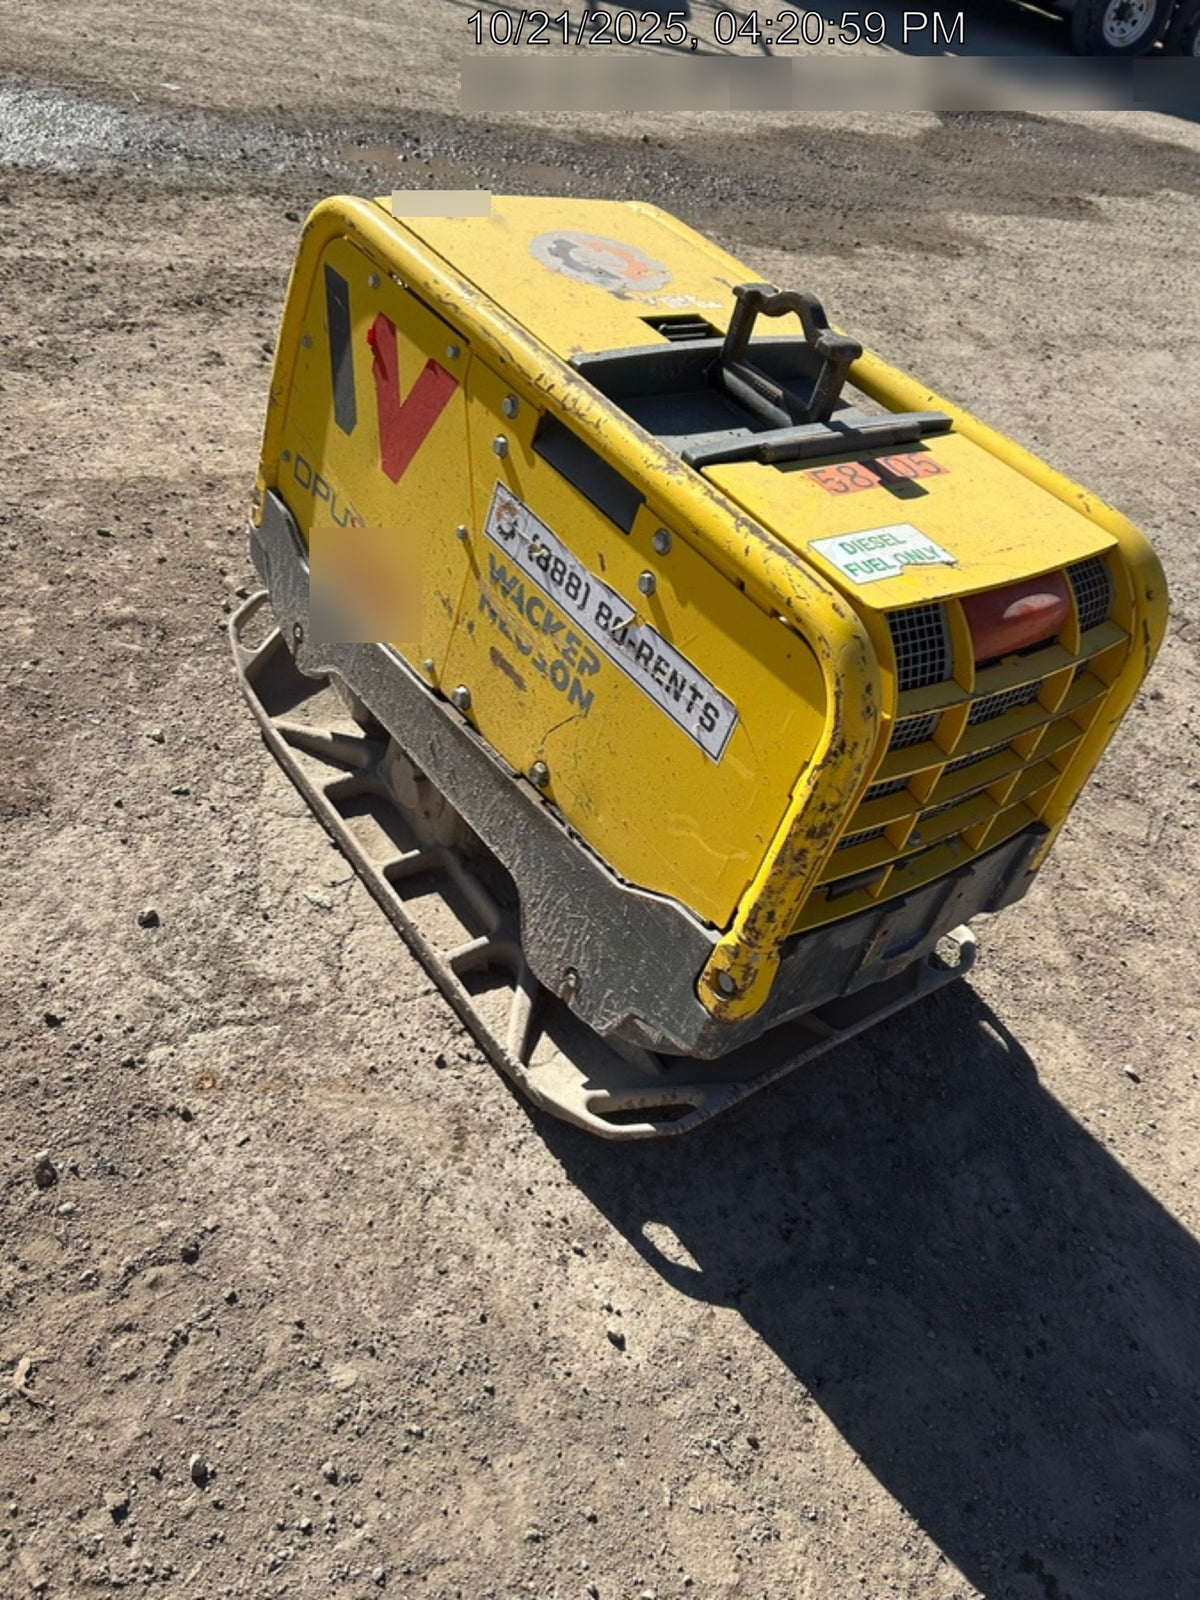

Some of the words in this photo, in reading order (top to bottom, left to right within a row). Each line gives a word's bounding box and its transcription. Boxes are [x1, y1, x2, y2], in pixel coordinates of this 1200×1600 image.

[839, 532, 907, 555] DIESEL
[844, 557, 896, 577] FUEL
[892, 545, 941, 565] ONLY
